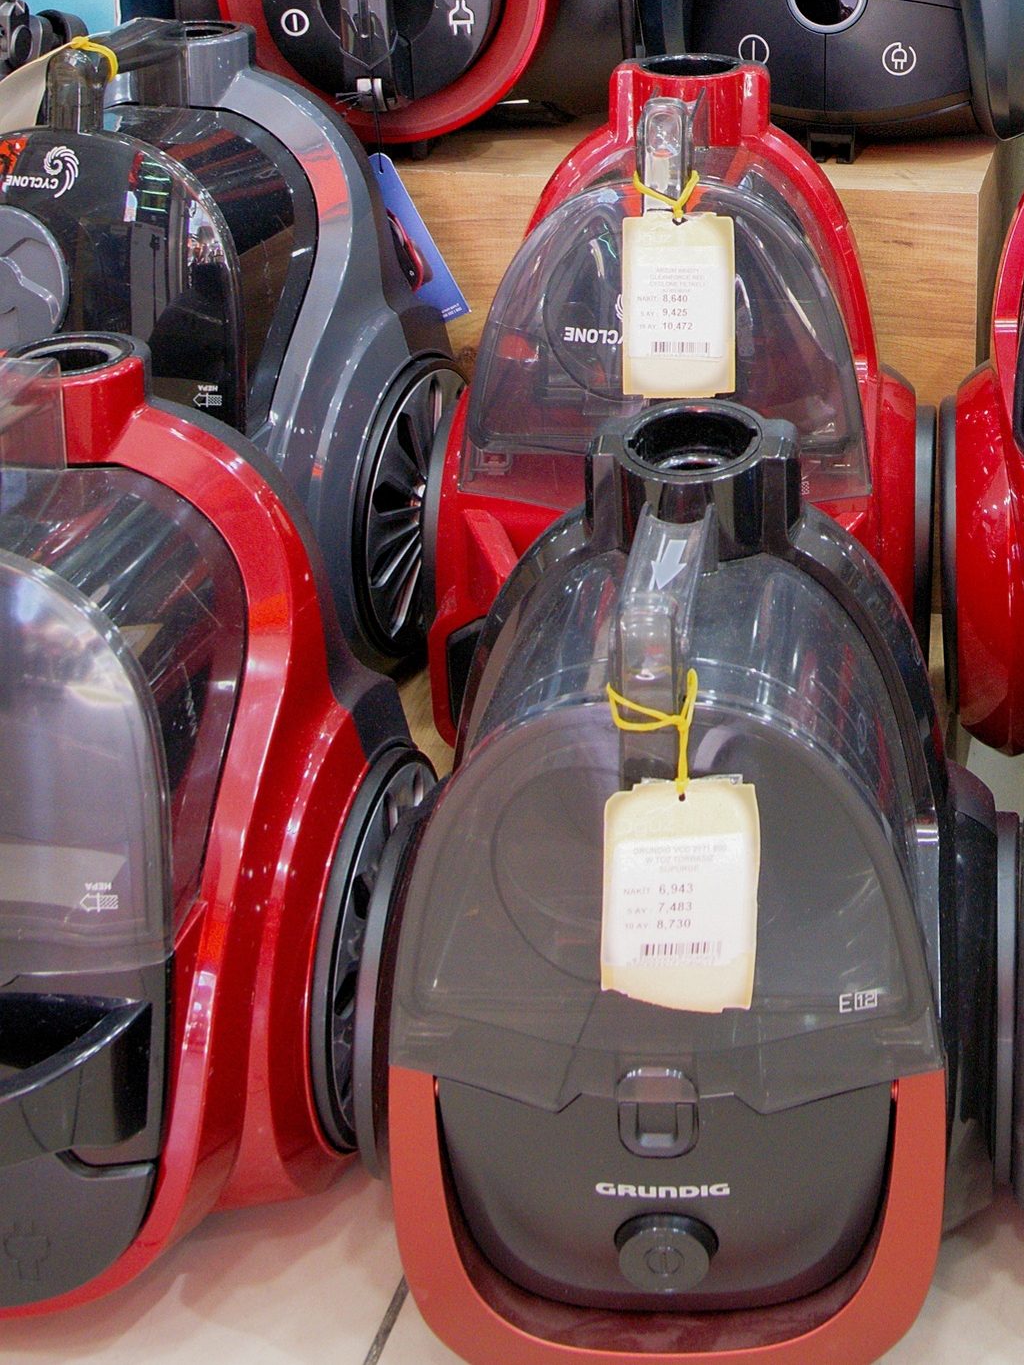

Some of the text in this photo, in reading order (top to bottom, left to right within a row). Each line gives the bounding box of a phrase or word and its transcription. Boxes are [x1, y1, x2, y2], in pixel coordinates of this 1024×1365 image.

[5, 173, 61, 191] CYCLONE
[662, 294, 689, 303] 8,640
[662, 308, 689, 318] 9,425
[662, 322, 694, 332] 10,472
[564, 326, 623, 345] CLONE
[658, 883, 695, 896] 6,943
[658, 901, 692, 915] 7,483
[656, 918, 692, 931] 8,730
[595, 1182, 731, 1199] GRUNDIG
